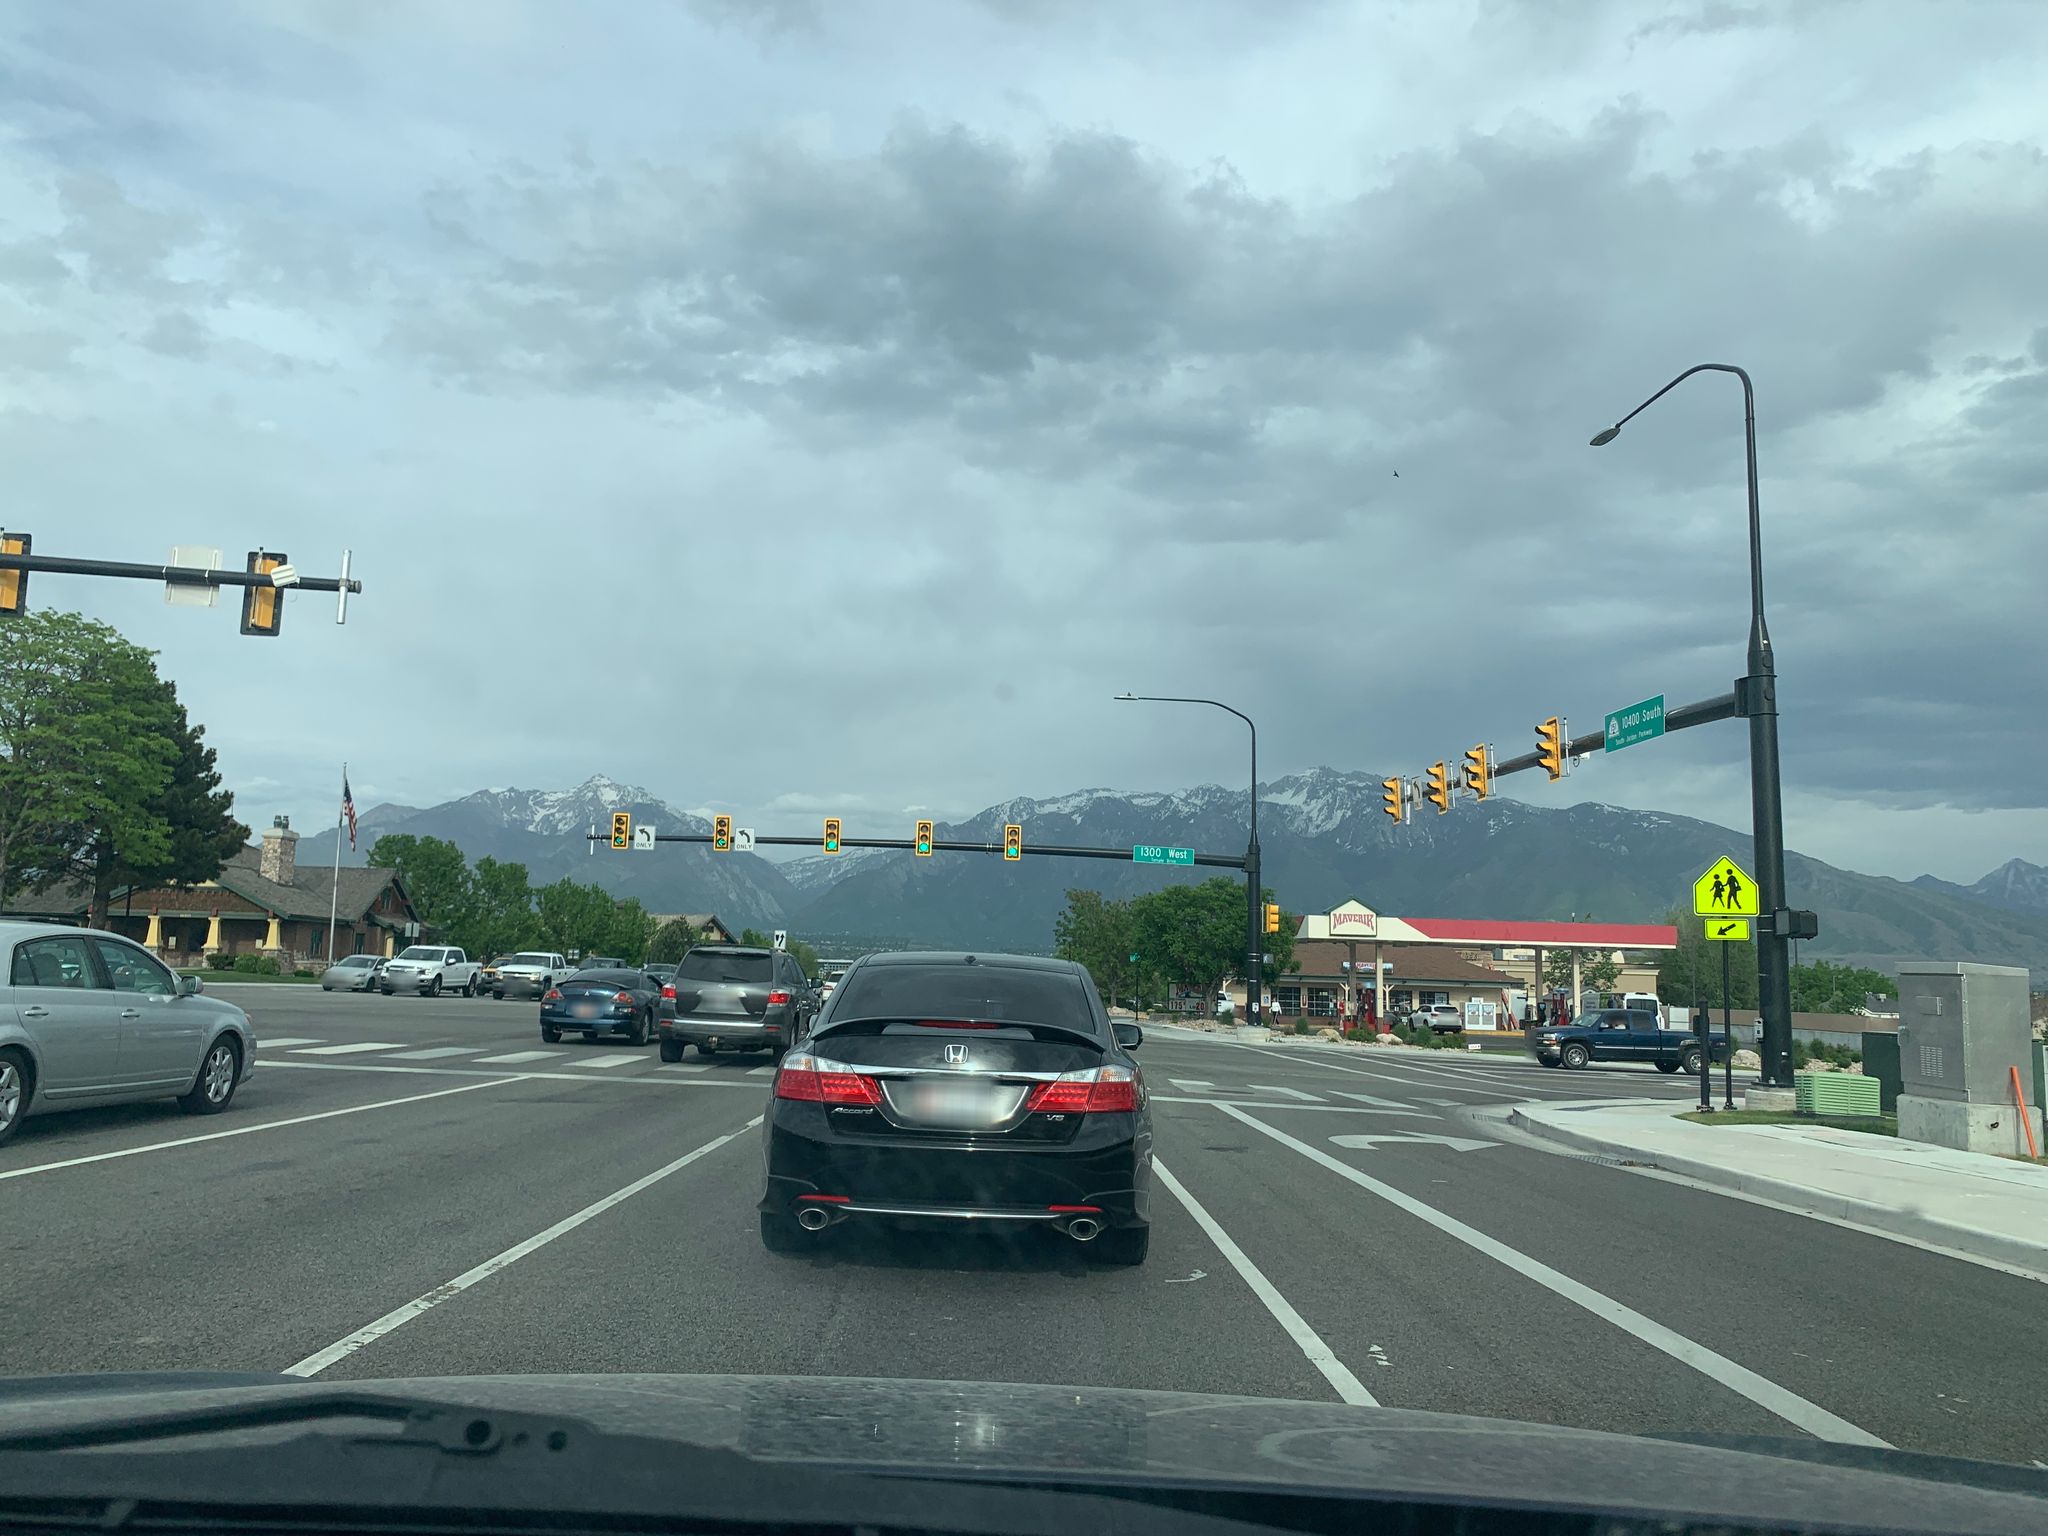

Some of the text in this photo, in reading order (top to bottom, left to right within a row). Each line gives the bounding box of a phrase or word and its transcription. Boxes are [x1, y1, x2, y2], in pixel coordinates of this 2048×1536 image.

[1622, 704, 1661, 730] 10400 South
[1140, 847, 1187, 859] 1300 West
[1332, 913, 1375, 931] MAVERIK
[831, 1107, 874, 1115] Accord
